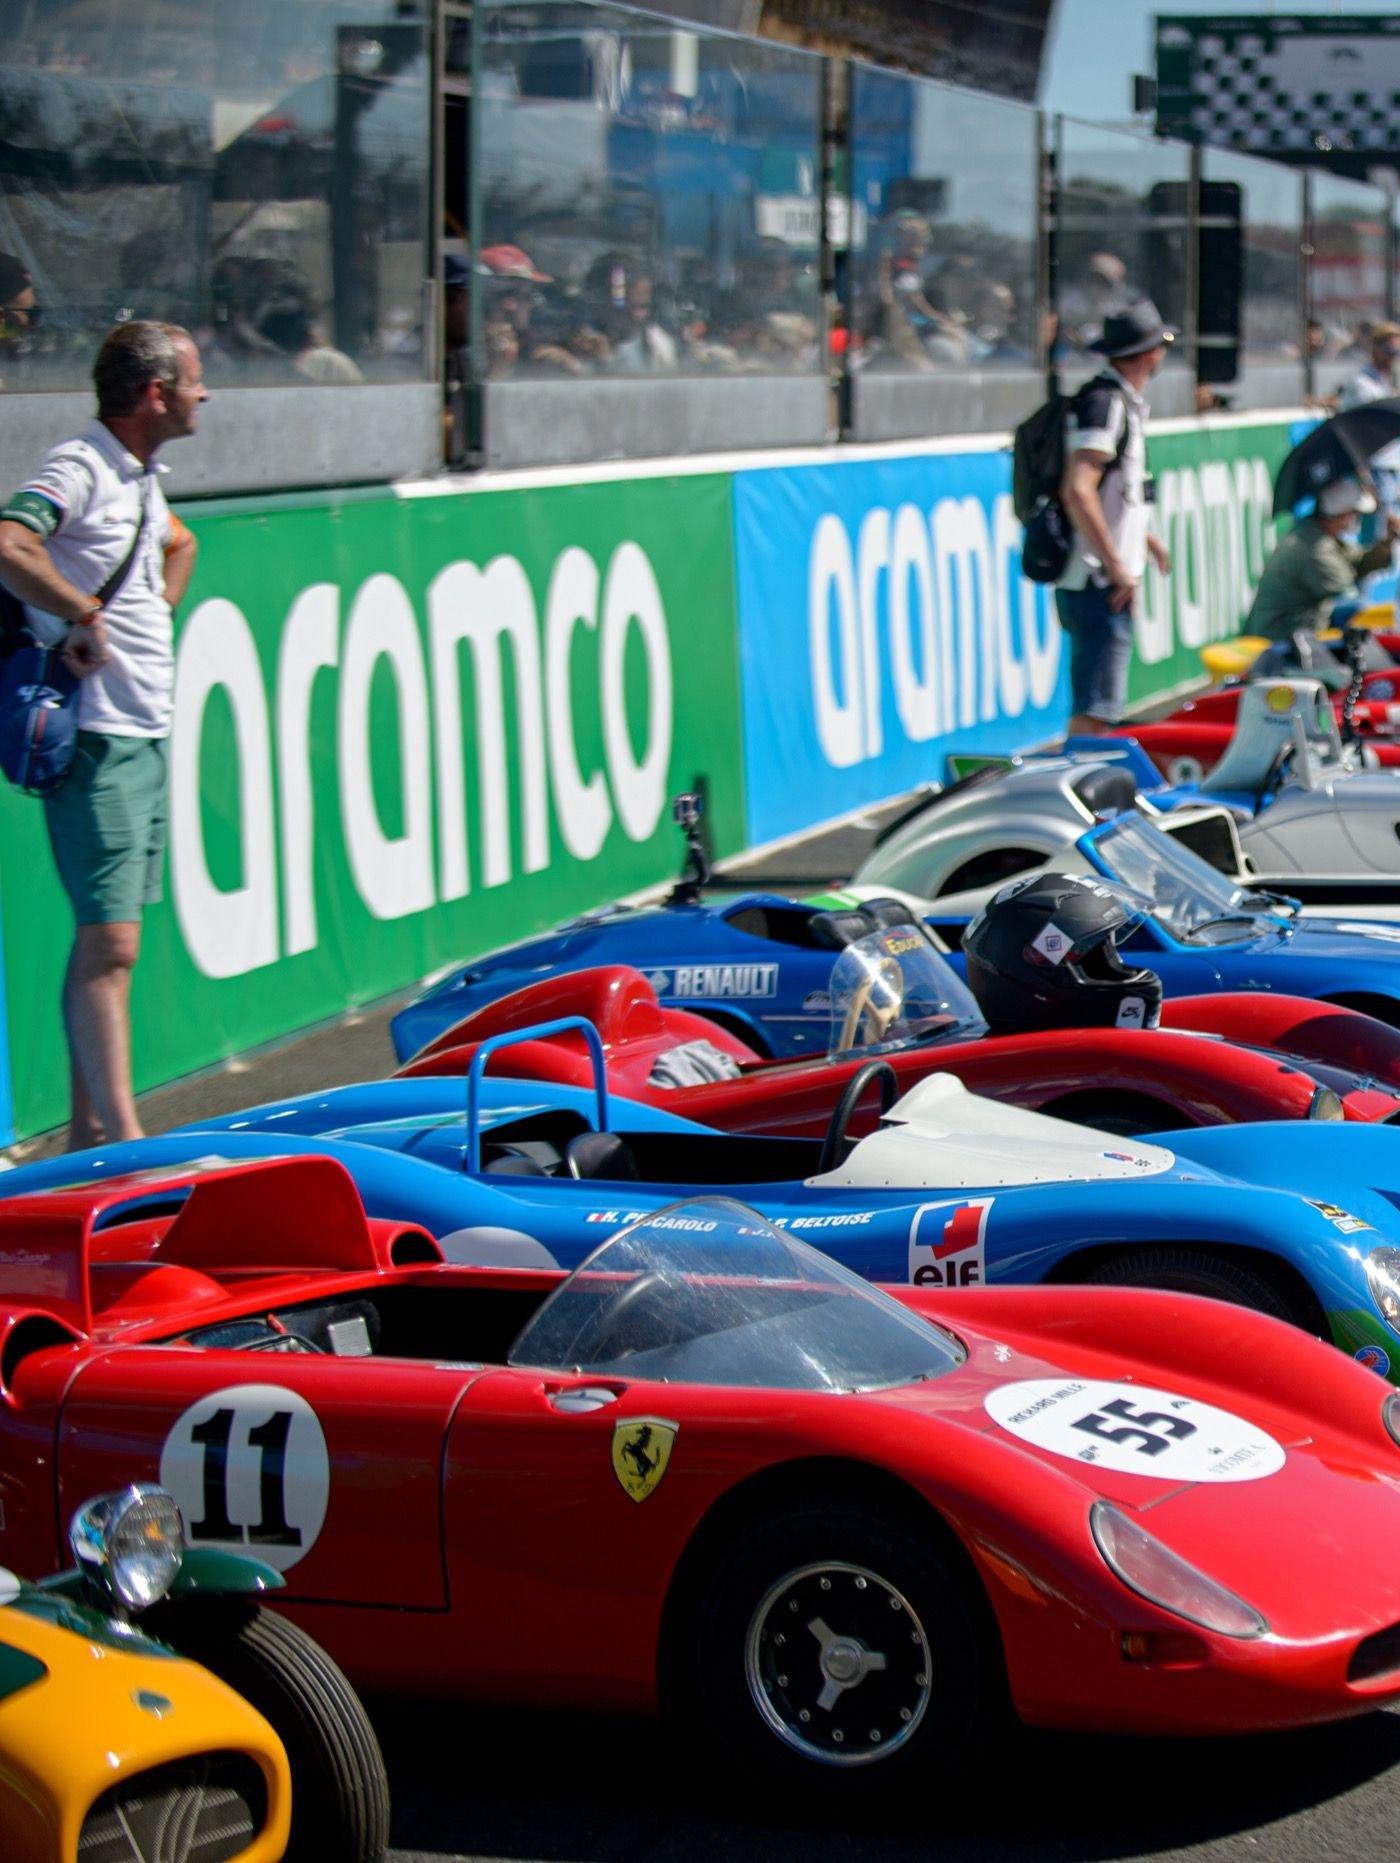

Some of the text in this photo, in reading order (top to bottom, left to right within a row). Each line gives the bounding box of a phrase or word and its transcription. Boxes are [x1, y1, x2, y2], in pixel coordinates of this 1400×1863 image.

[807, 492, 1062, 769] aramco
[170, 541, 673, 979] aramco
[674, 967, 775, 997] RENAULT
[601, 1211, 617, 1223] H.
[791, 1212, 876, 1229] BELTOISE
[914, 1260, 979, 1287] elf
[1070, 1399, 1198, 1457] 55
[190, 1408, 302, 1546] 11
